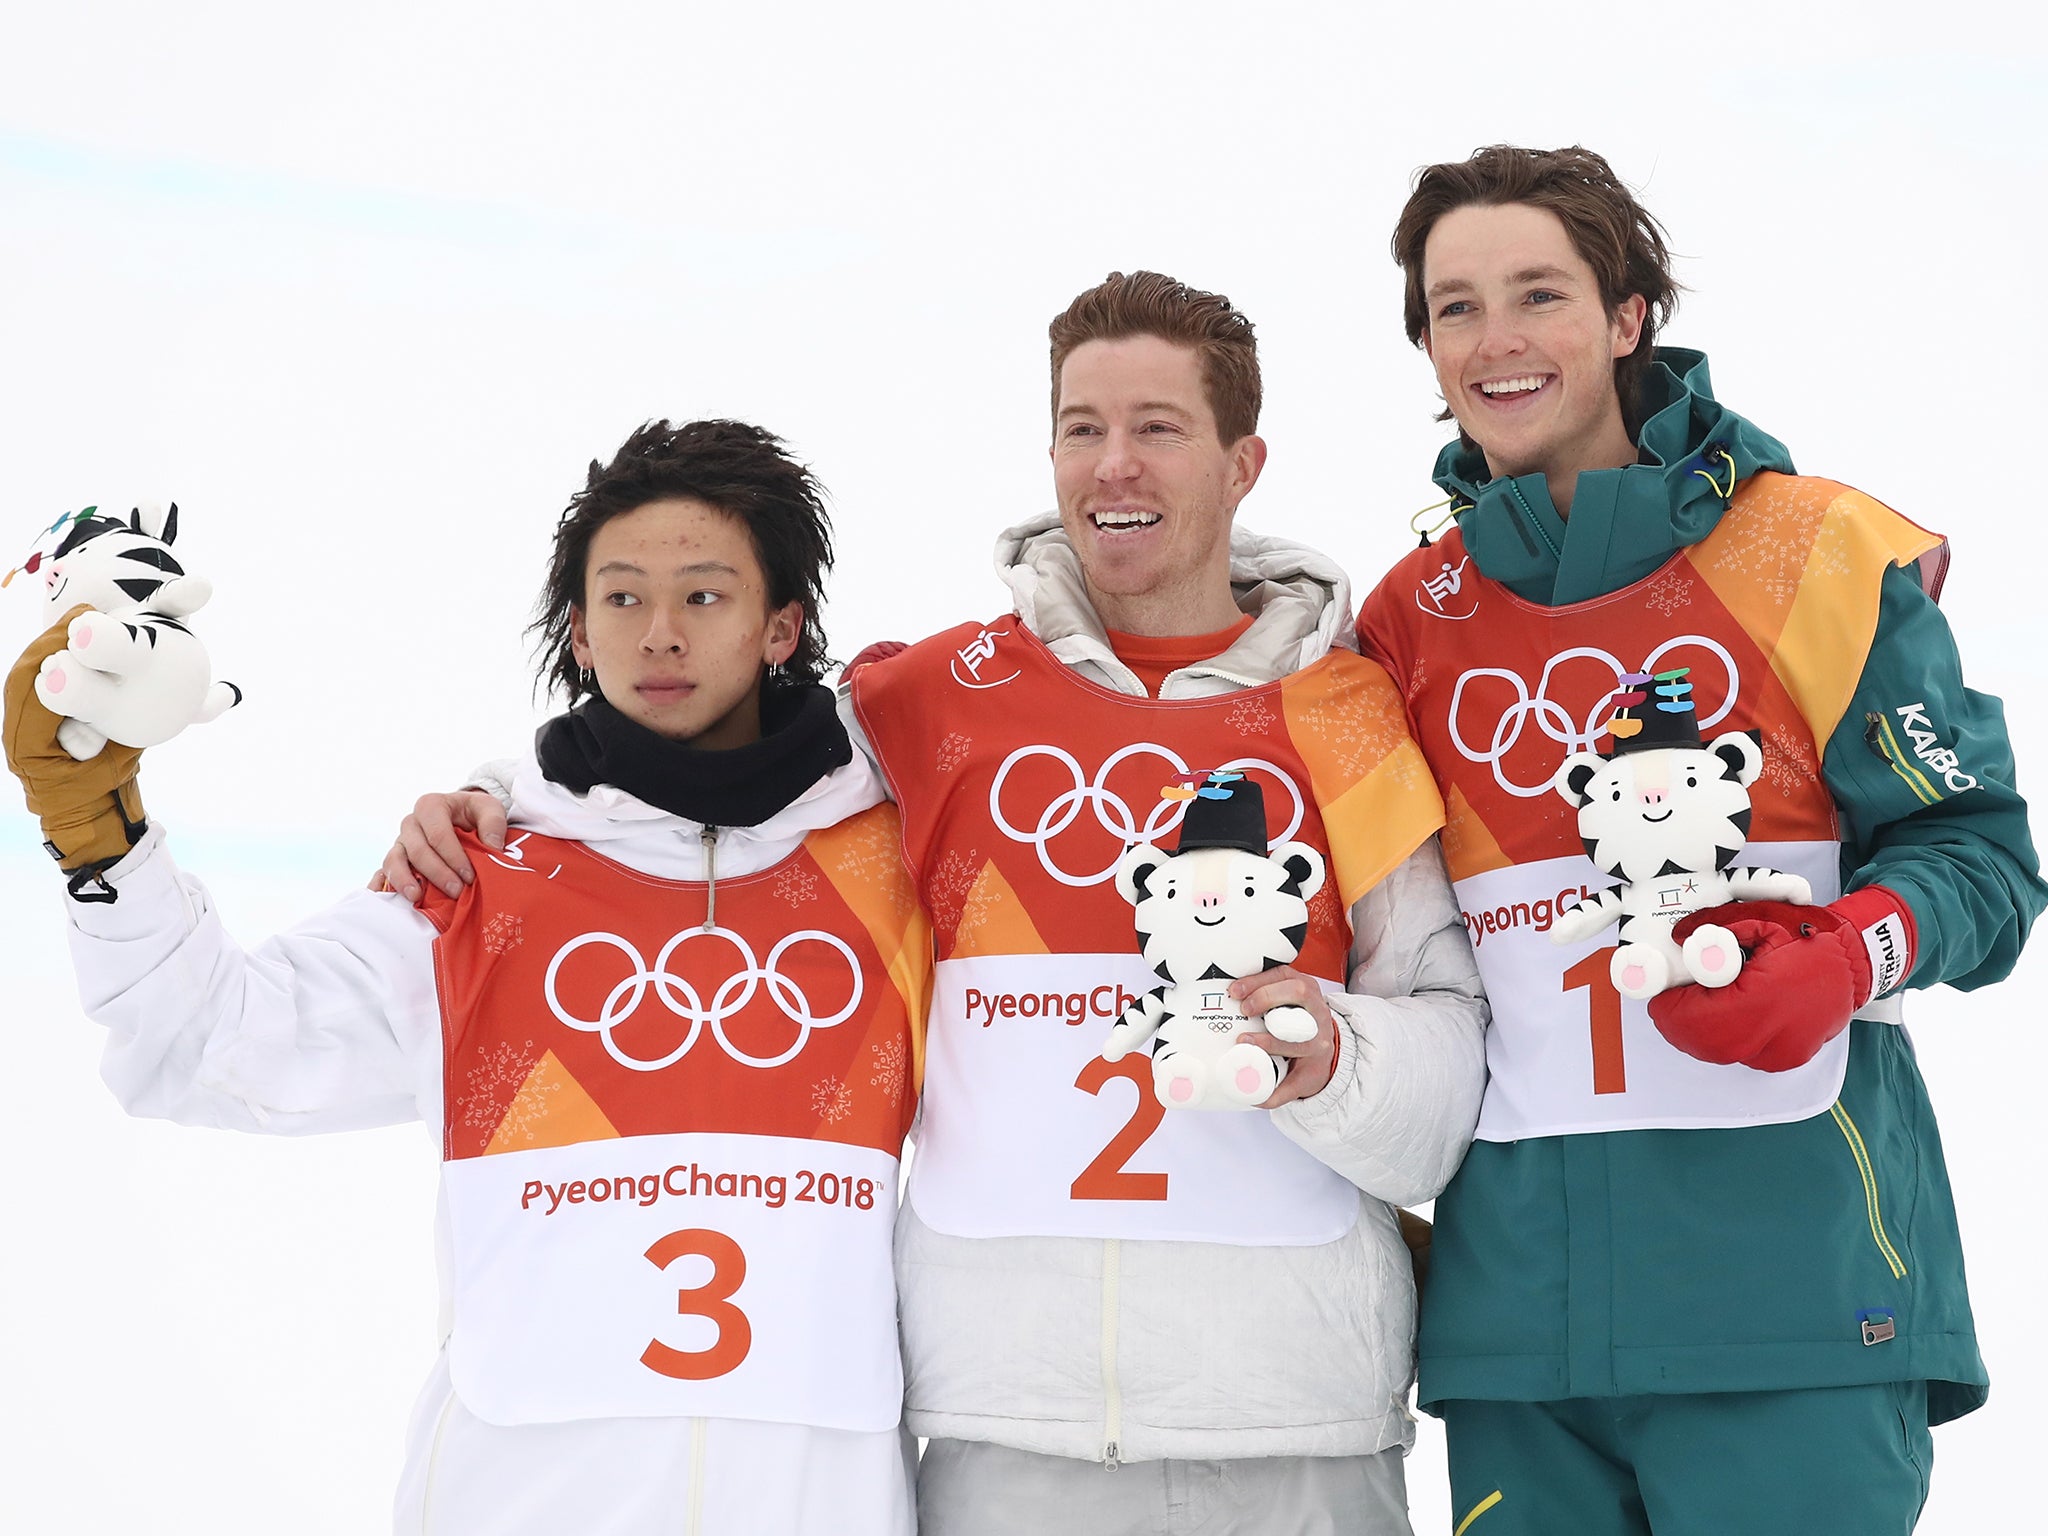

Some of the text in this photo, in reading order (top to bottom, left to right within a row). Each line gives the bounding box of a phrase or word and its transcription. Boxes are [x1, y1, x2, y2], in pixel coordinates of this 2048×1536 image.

[1896, 702, 1985, 793] KABO
[965, 984, 1136, 1027] PyeongCh
[1563, 946, 1626, 1094] 1
[1070, 1051, 1168, 1201] 2
[521, 1163, 787, 1216] PyeongChang
[795, 1170, 874, 1210] 2018
[640, 1228, 752, 1381] 3
